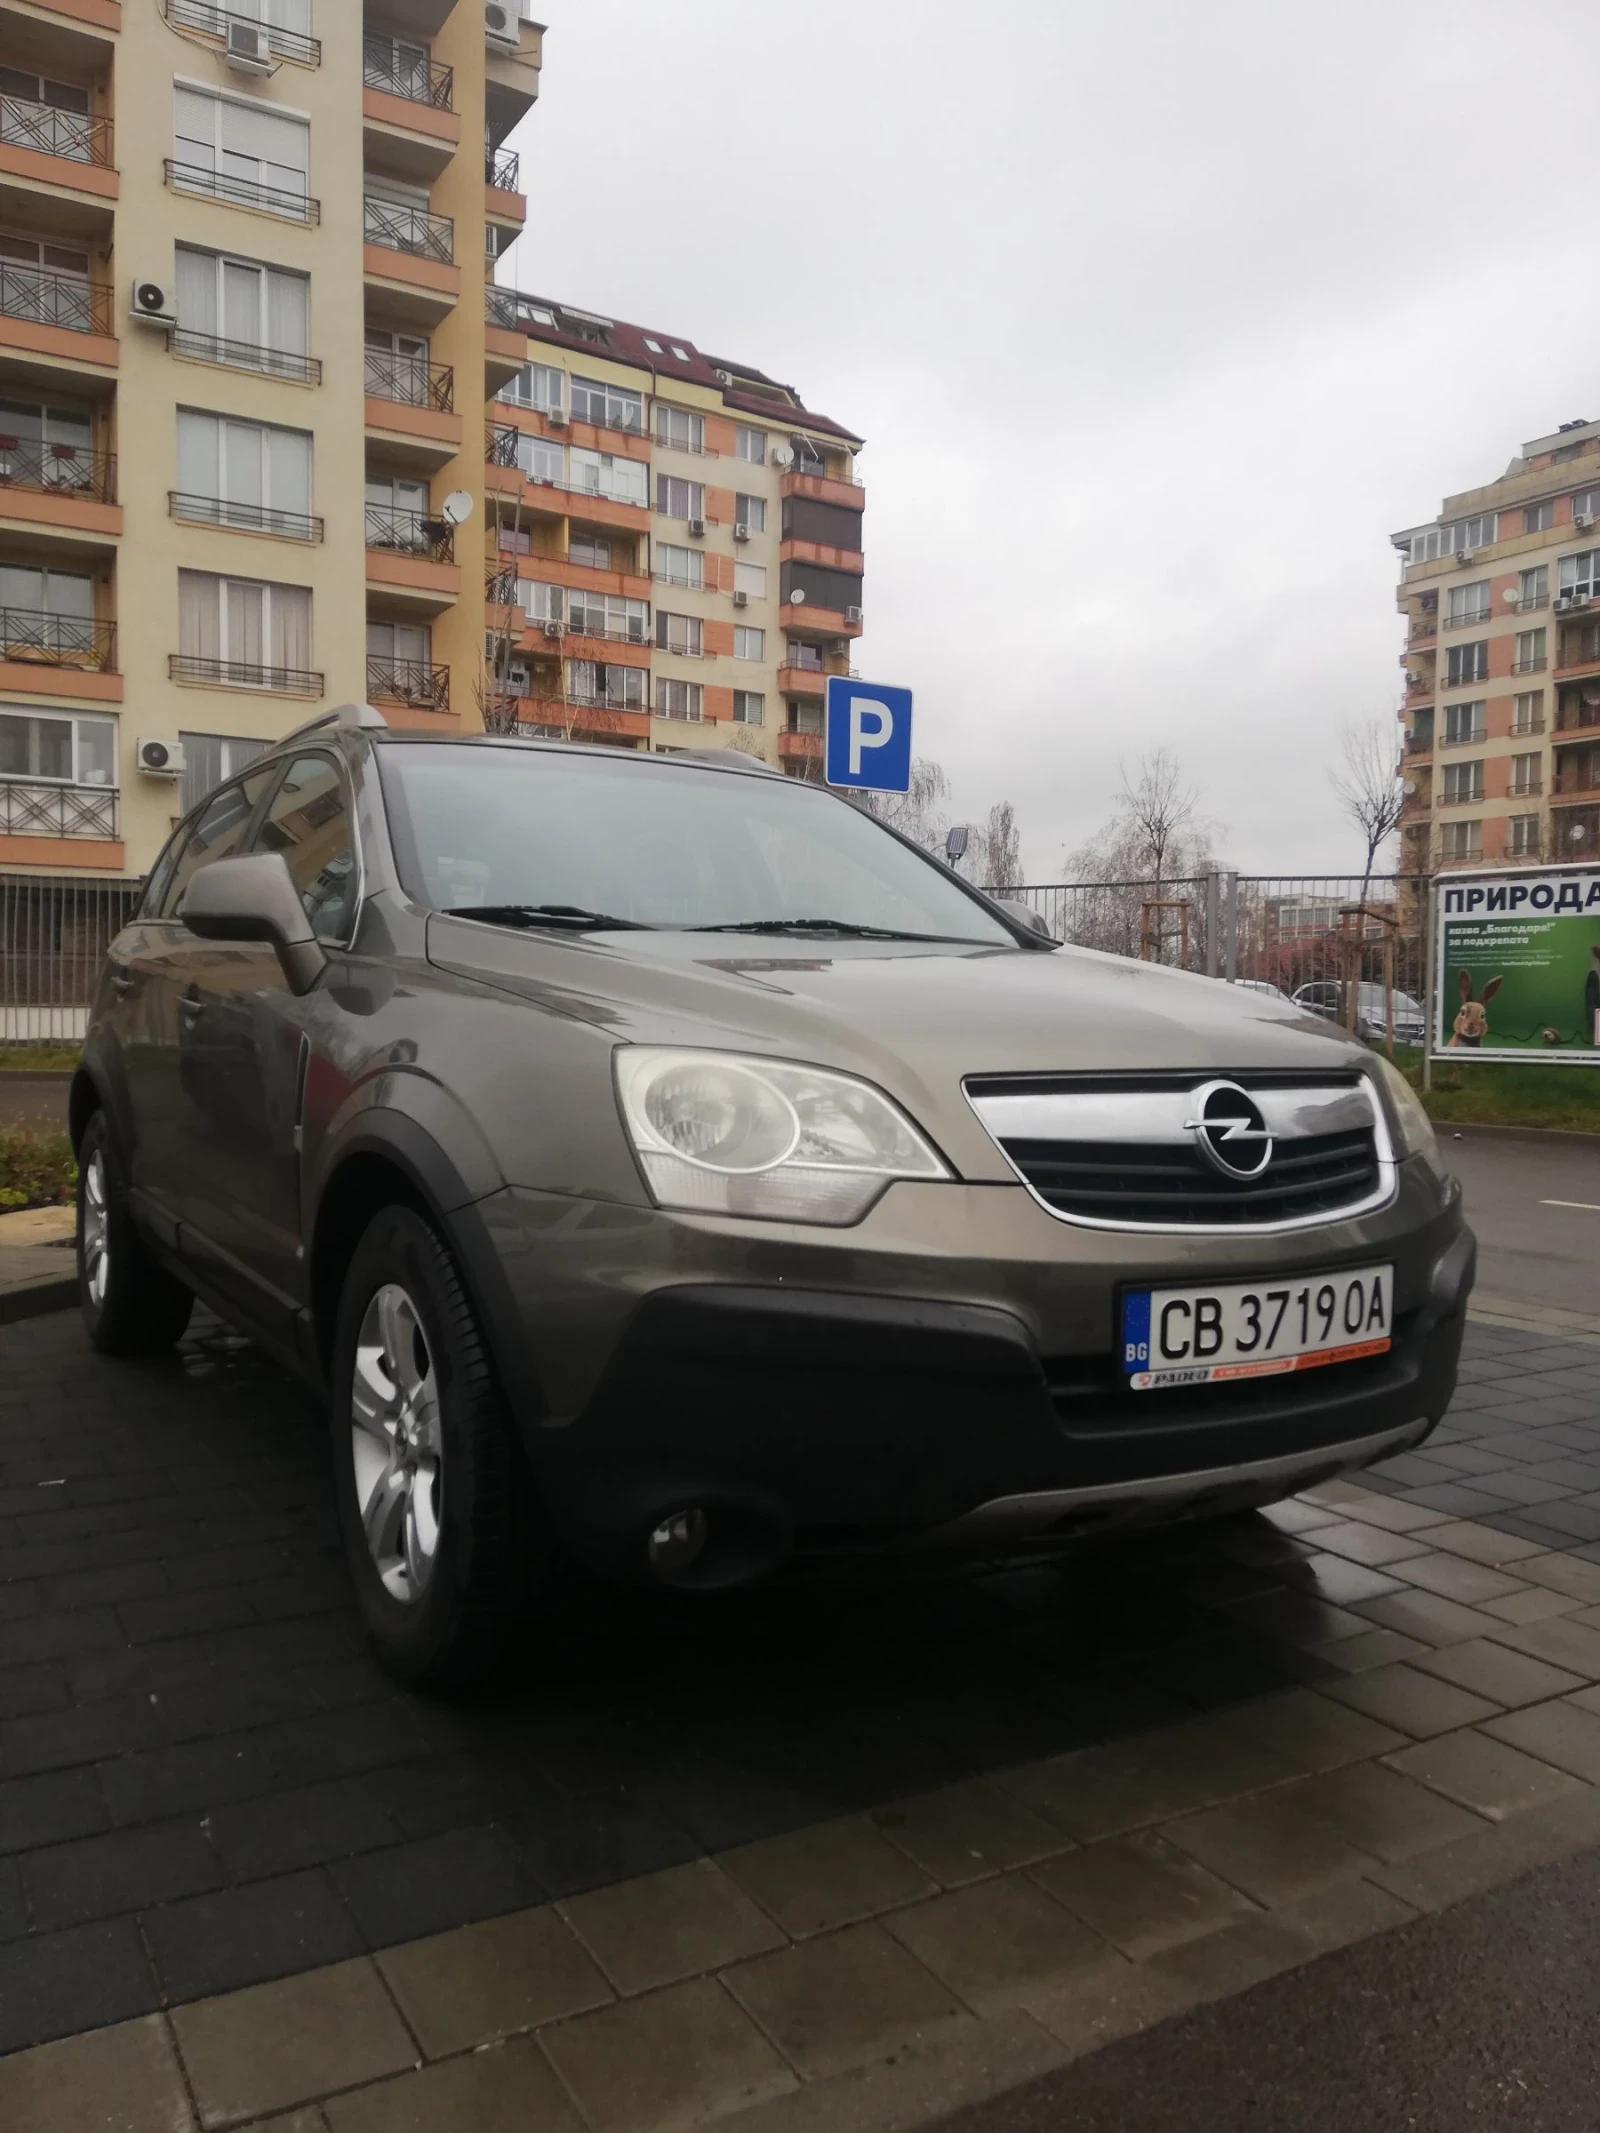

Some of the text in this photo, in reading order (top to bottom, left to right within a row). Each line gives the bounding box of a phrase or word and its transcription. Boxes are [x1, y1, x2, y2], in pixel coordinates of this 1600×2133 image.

[849, 696, 894, 775] P
[1448, 937, 1529, 947] за подкрепата
[1125, 1342, 1148, 1362] BG
